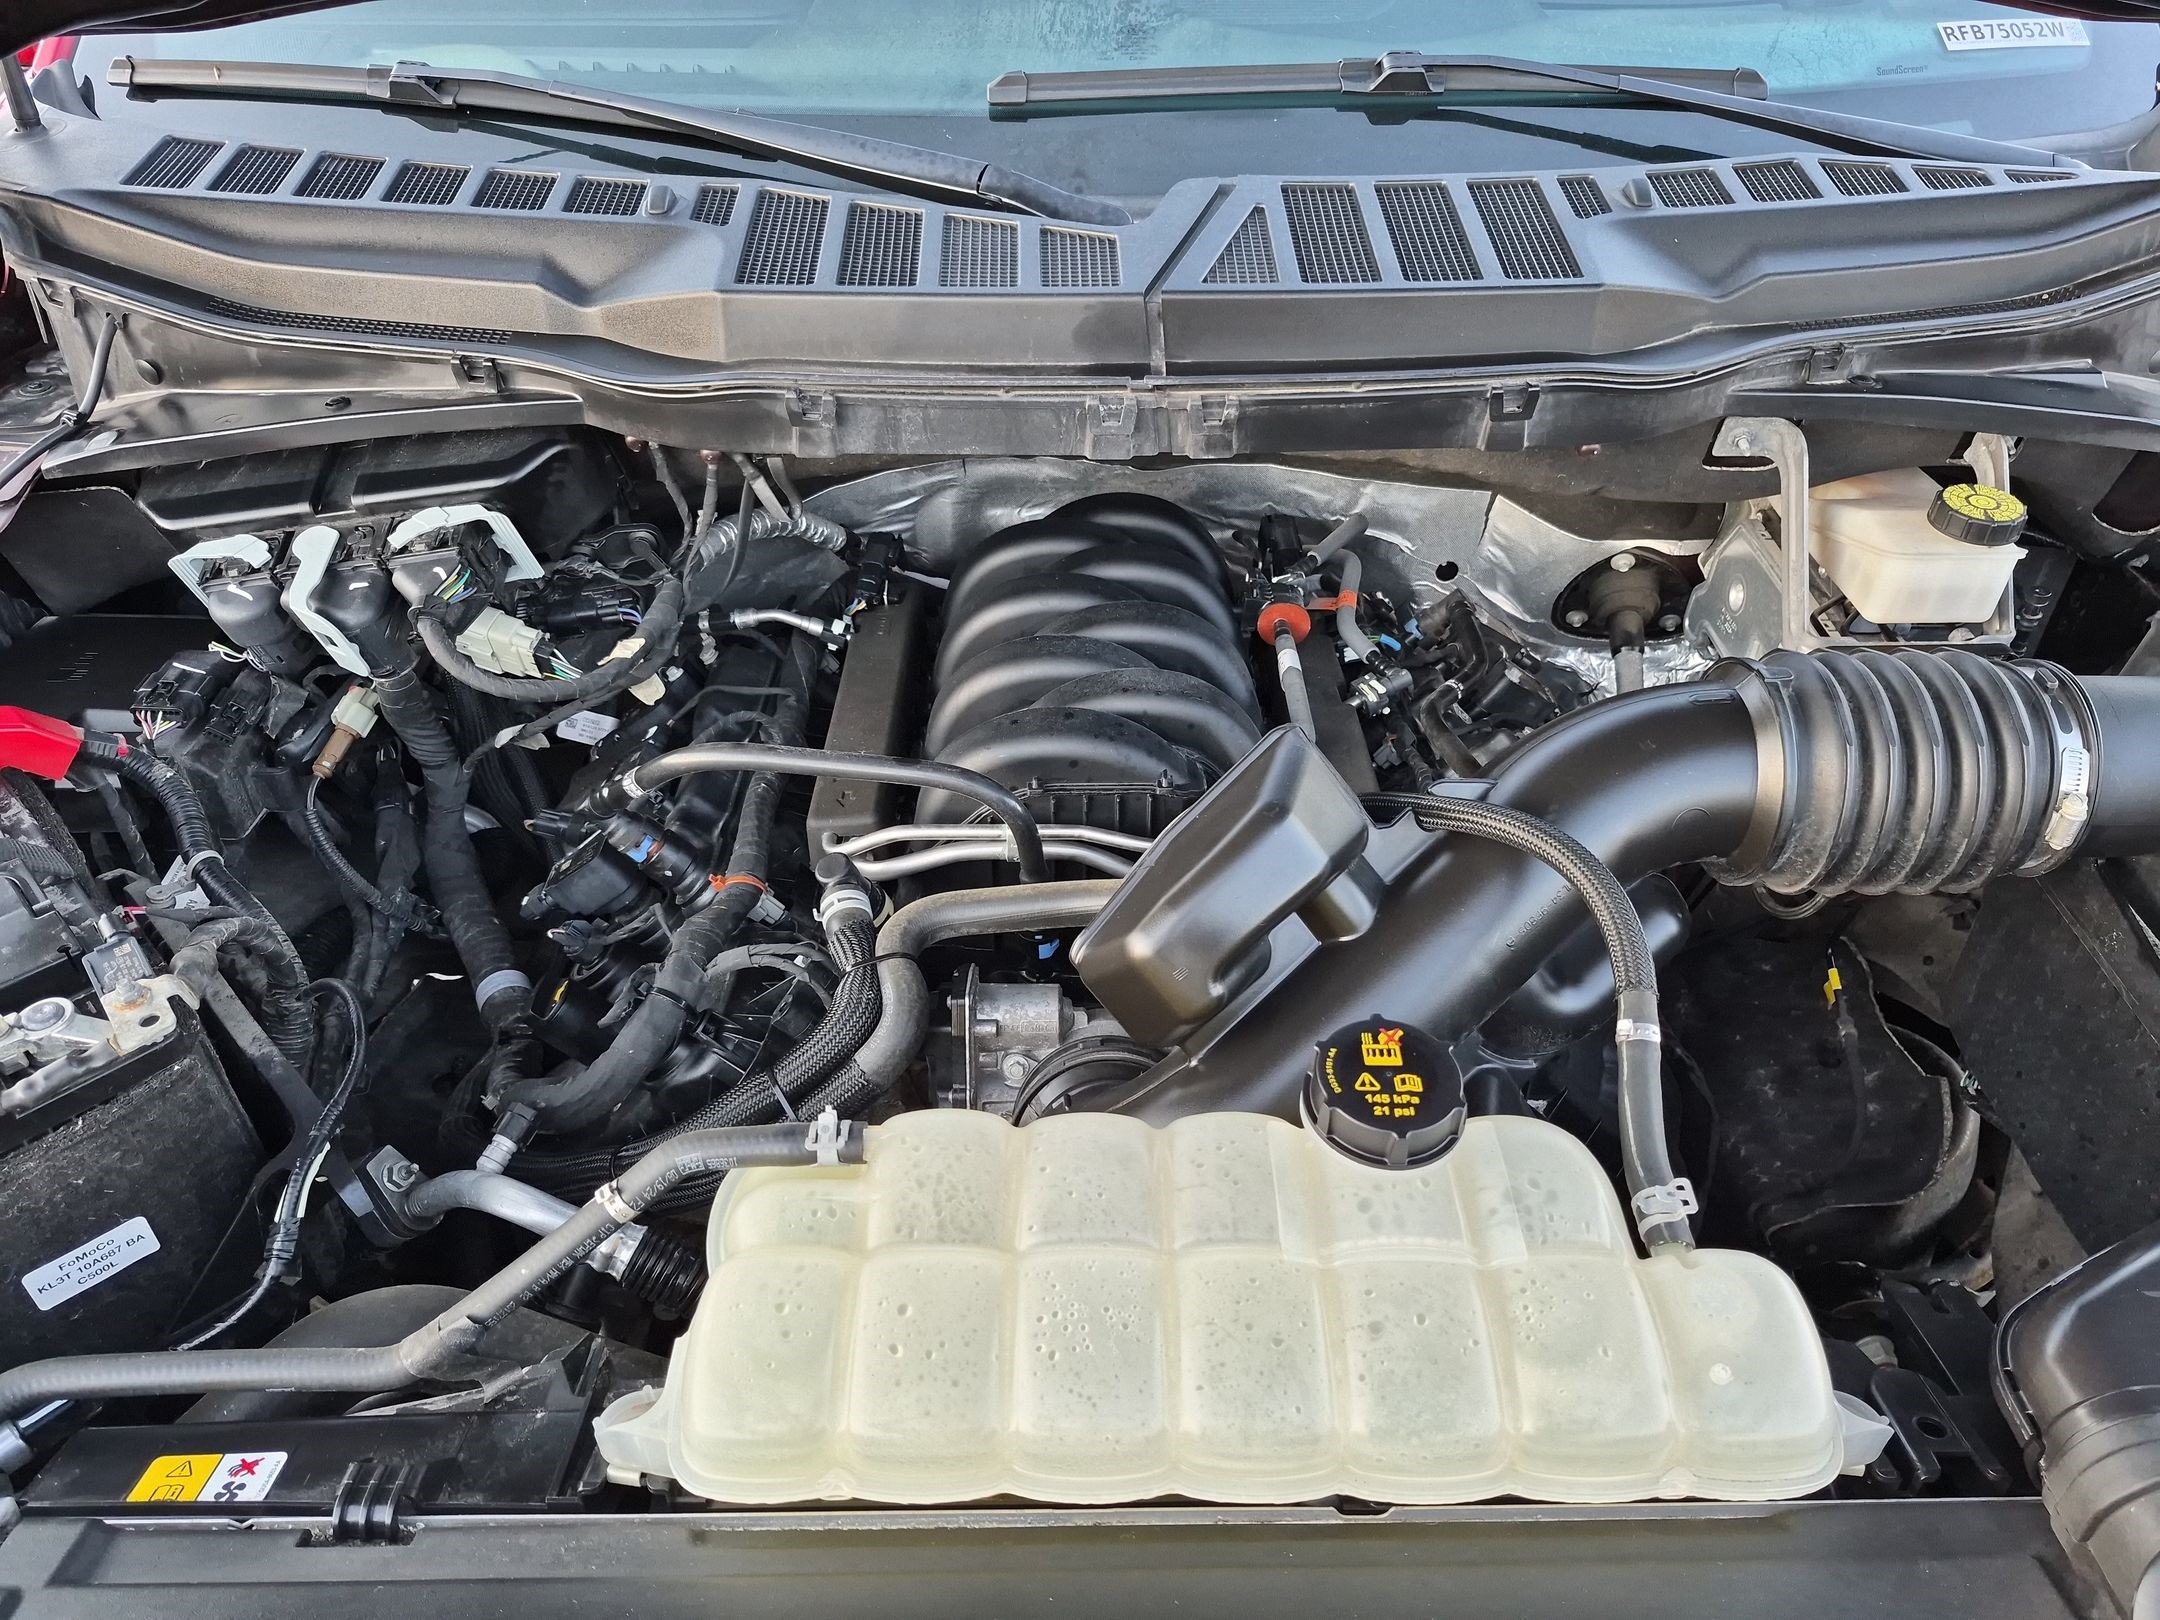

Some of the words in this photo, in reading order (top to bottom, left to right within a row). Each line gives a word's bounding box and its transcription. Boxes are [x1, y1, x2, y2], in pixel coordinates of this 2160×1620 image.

[1942, 22, 2065, 42] RFB75052W
[1364, 1094, 1390, 1104] 145
[1393, 1094, 1420, 1104] kPa
[1373, 1106, 1390, 1116] 21
[1394, 1106, 1416, 1118] psi
[36, 1272, 73, 1294] KL3T
[77, 1245, 122, 1274] 10A687
[125, 1233, 146, 1248] BA
[58, 1239, 115, 1271] FoMoCo
[77, 1261, 119, 1285] C500L
